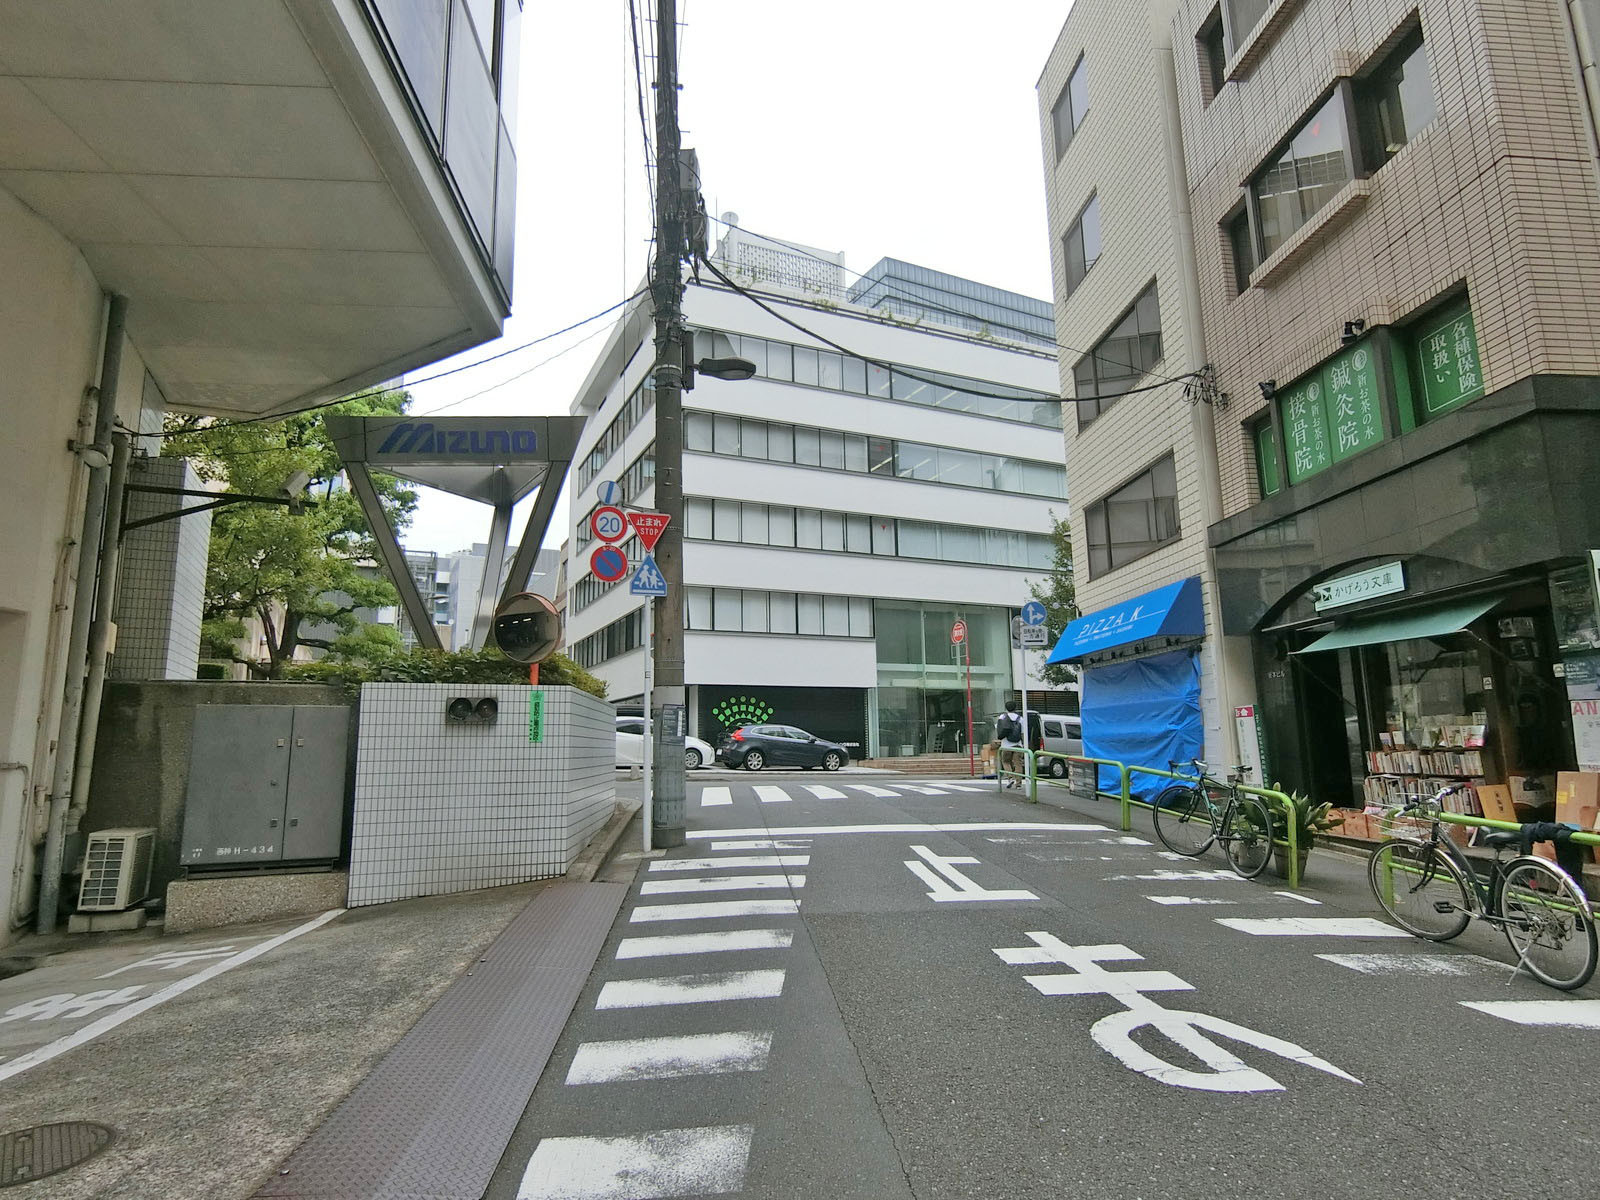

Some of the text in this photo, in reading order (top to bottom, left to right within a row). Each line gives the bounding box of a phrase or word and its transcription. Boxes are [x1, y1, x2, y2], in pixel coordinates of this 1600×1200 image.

[1430, 334, 1451, 383] 取扱い
[1451, 321, 1478, 393] 各種保険
[1330, 360, 1359, 453] 鍼灸院
[1357, 372, 1375, 440] 新お茶の水
[377, 423, 537, 453] MIZUNO
[1288, 392, 1313, 475] 接骨院
[1311, 403, 1326, 464] 新お茶の水
[599, 516, 620, 533] 20
[636, 517, 662, 527] 止まれ
[640, 527, 659, 535] STOP
[1335, 572, 1393, 598] かげろう文庫
[1078, 611, 1123, 638] PIZZA
[1129, 605, 1144, 622] K
